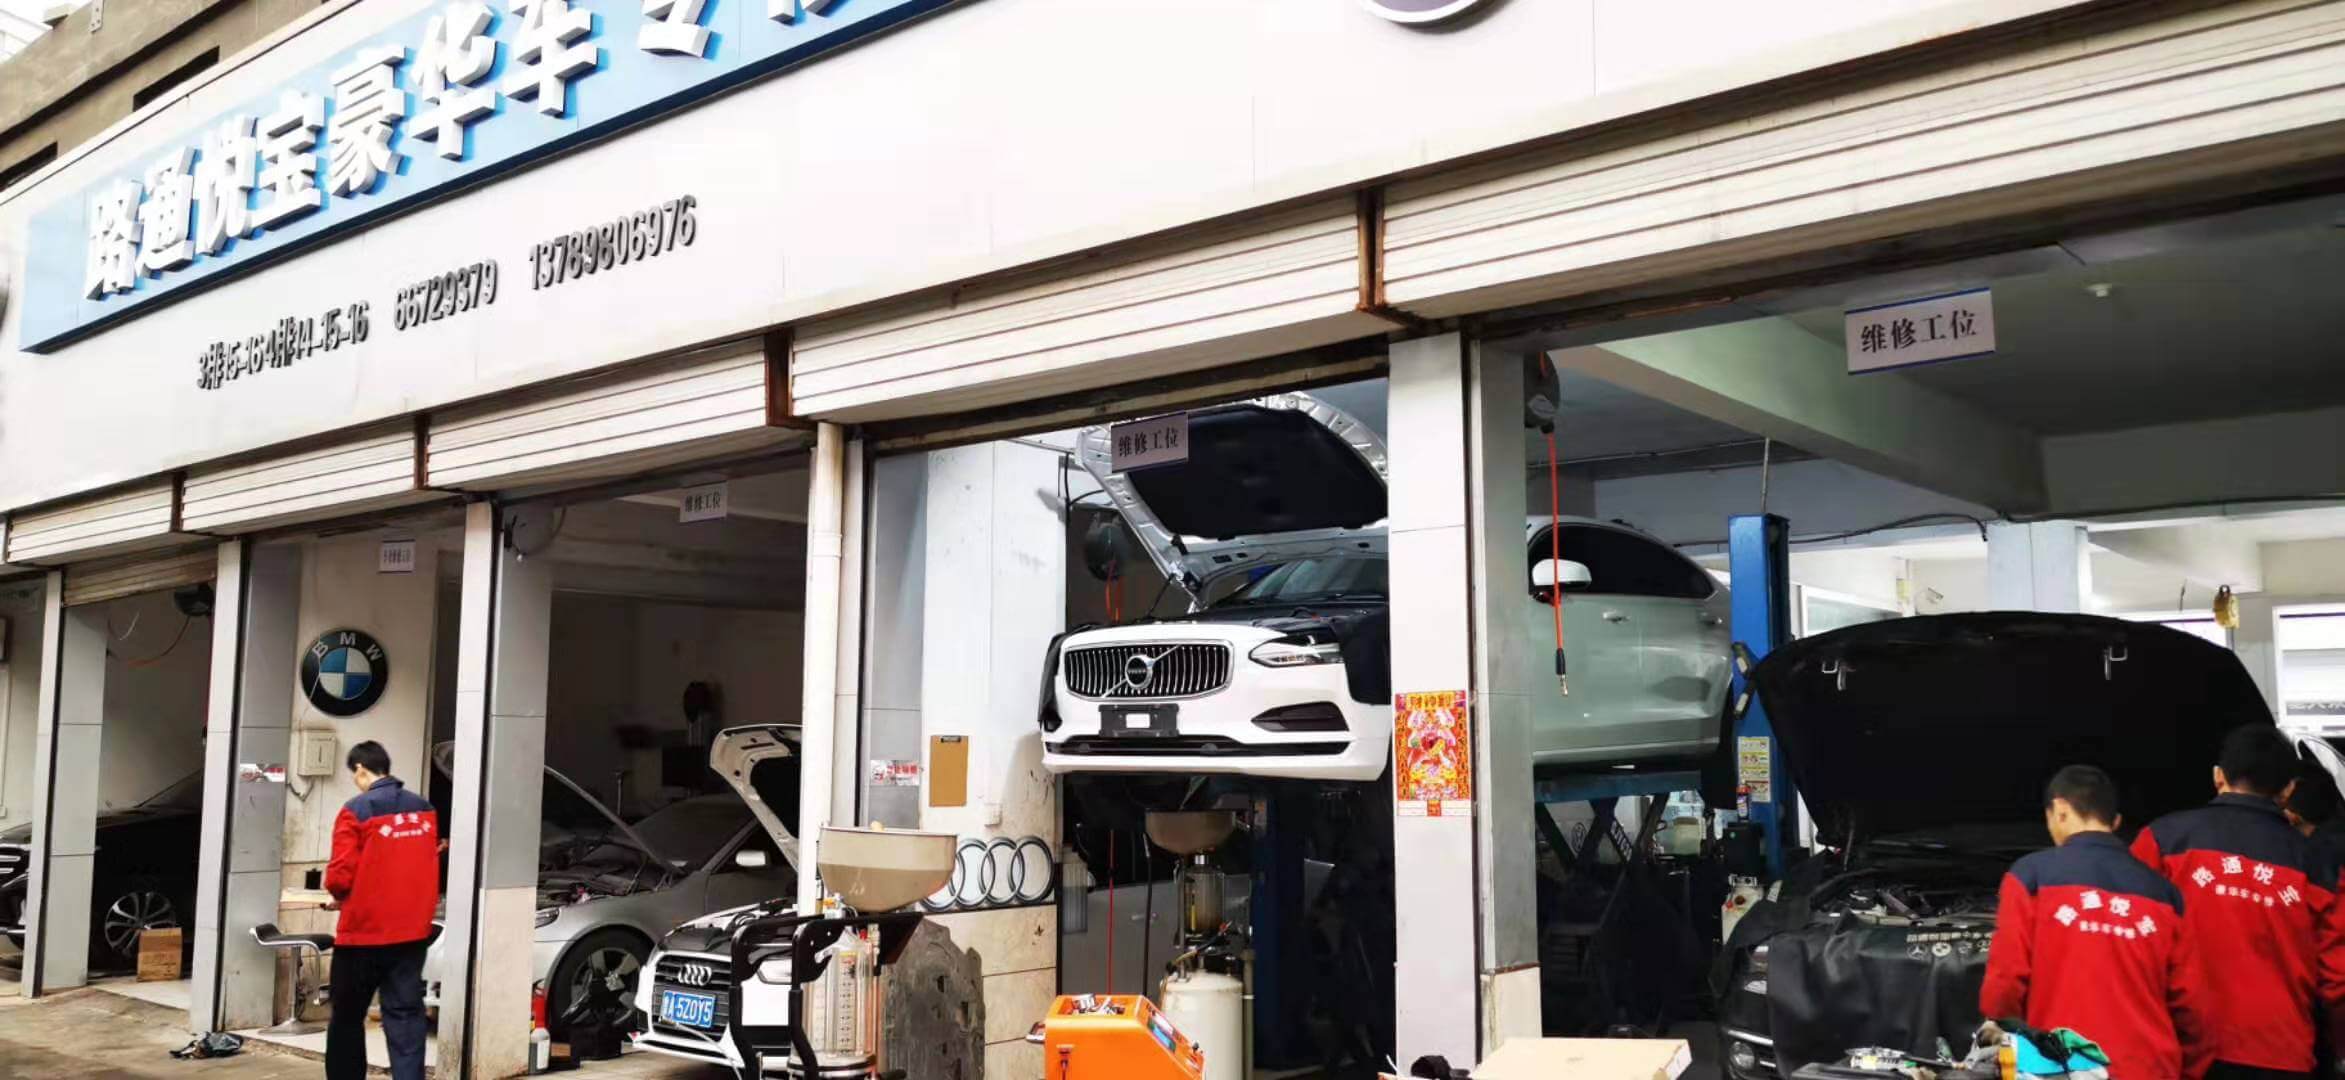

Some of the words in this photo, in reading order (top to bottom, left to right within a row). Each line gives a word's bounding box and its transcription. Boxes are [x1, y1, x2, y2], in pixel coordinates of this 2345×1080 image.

[393, 258, 499, 331] 66729379
[528, 194, 697, 290] 13789806976
[1860, 309, 1977, 353] 维修工位
[1118, 427, 1179, 458] 维修工位
[312, 631, 383, 661] BMW
